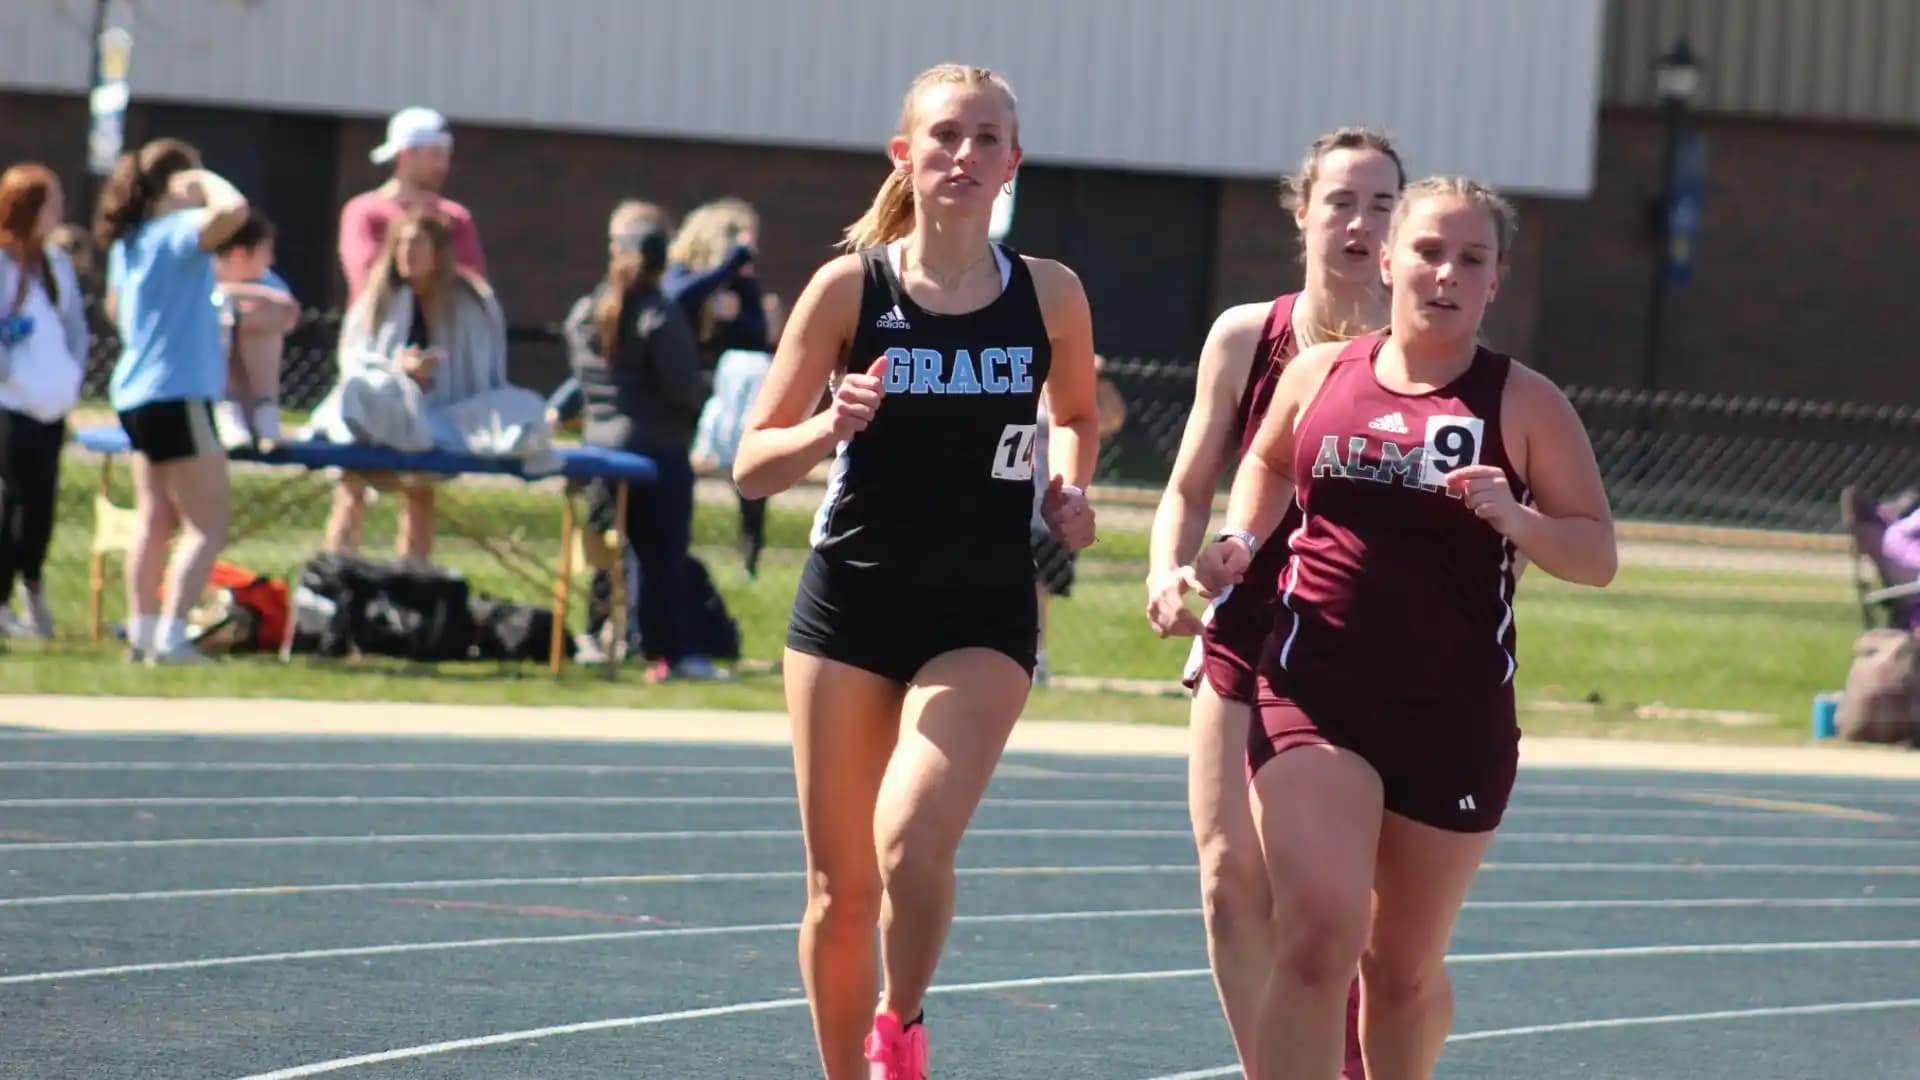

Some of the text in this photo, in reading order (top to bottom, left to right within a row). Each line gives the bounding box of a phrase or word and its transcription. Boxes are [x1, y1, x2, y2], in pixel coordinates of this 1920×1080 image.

[876, 319, 911, 330] adidas
[882, 347, 1033, 394] GRACE
[1312, 435, 1463, 499] ALM
[1434, 425, 1475, 474] 9
